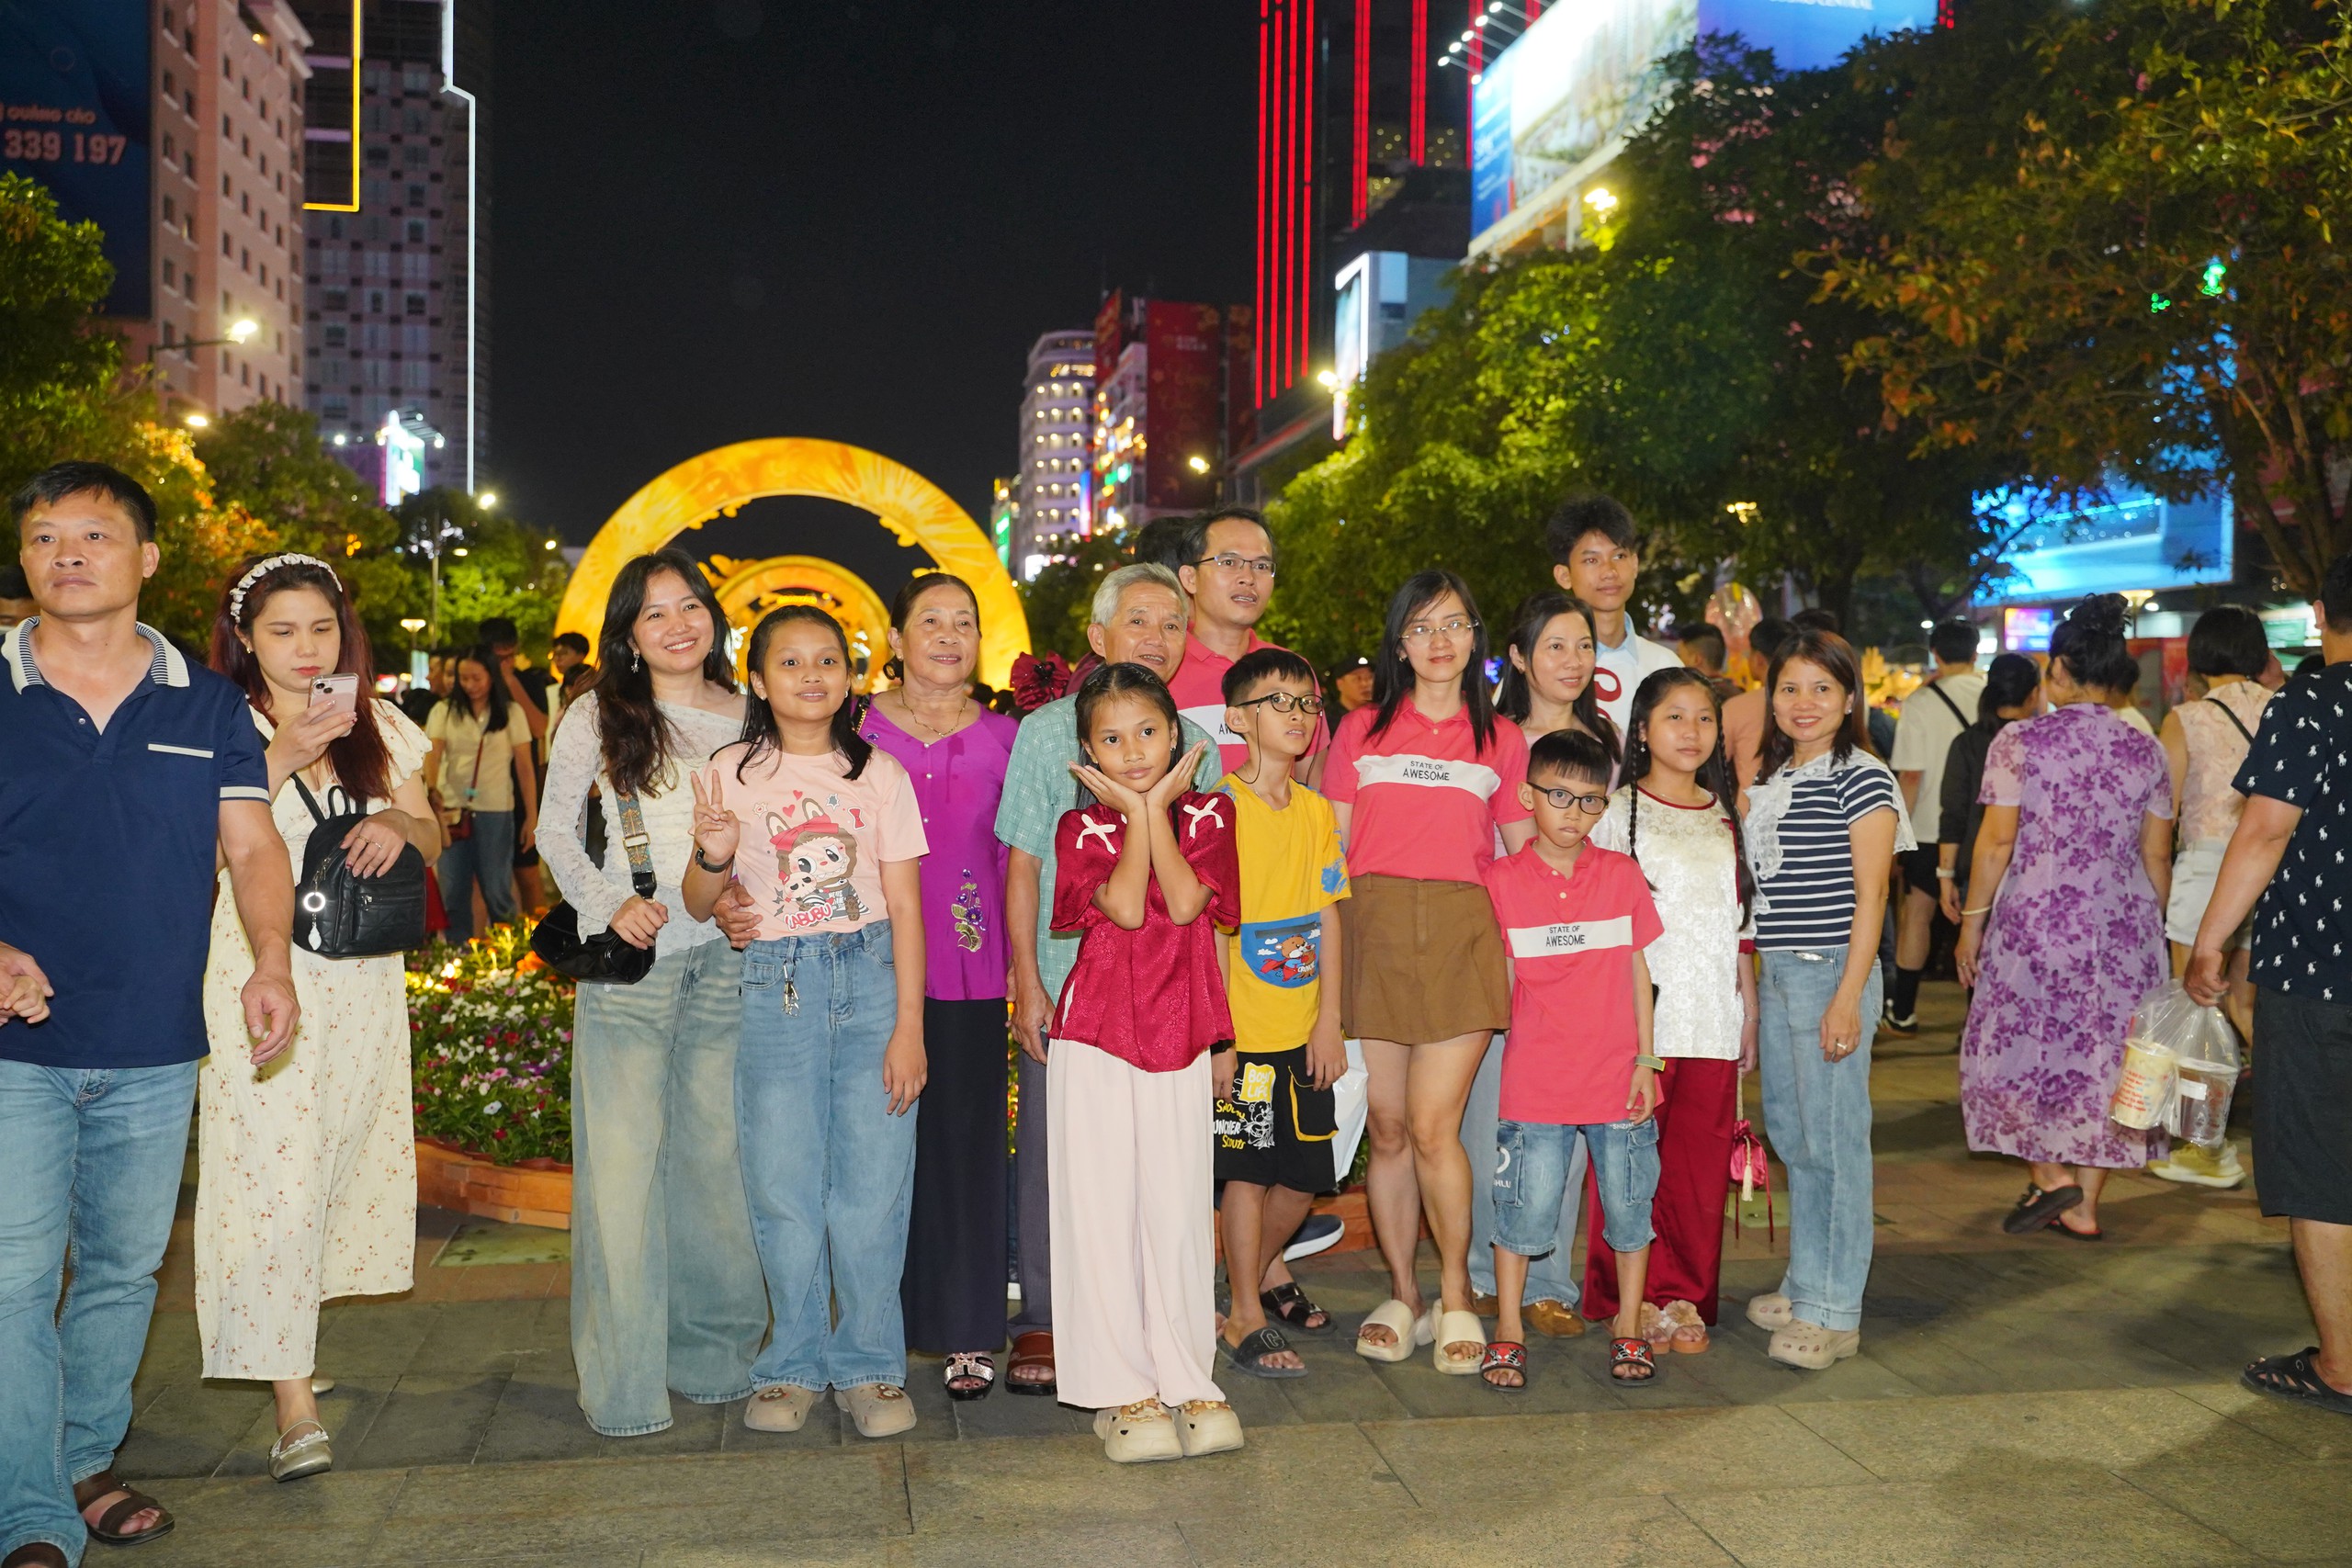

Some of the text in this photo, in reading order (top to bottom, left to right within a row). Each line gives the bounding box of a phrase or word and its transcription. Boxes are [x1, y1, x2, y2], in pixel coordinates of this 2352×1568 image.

[5, 129, 127, 165] 339 197
[1410, 760, 1432, 770] STATE
[1403, 767, 1450, 781] AWESOME
[1548, 926, 1570, 934] STATE
[1545, 934, 1586, 947] AWESOME
